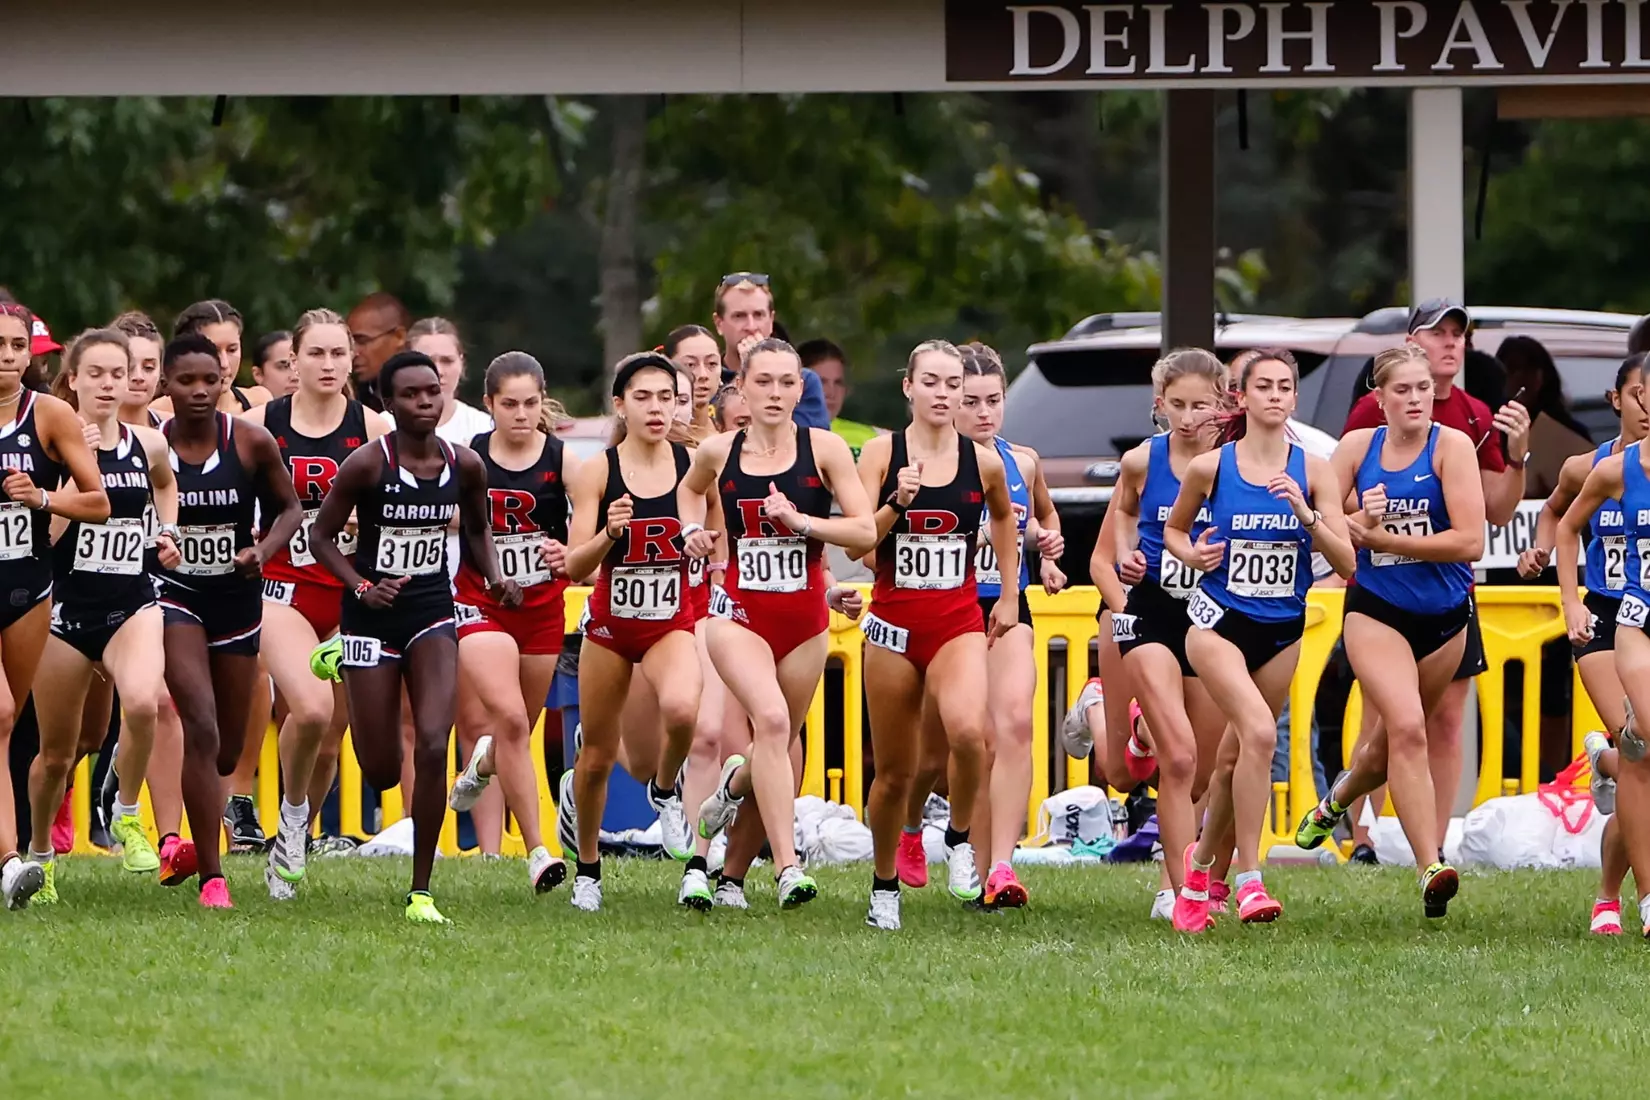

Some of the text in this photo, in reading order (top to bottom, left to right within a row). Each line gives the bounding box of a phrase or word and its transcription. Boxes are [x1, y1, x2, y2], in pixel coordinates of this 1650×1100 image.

[1008, 3, 1334, 76] DELPH
[289, 456, 338, 500] R
[383, 503, 454, 520] CAROLIN
[487, 488, 540, 534] R
[1231, 514, 1299, 530] BUFFALO
[78, 528, 141, 562] 3102
[184, 536, 232, 565] 099
[380, 537, 441, 569] 3105
[623, 517, 682, 564] R
[502, 545, 547, 577] 012
[741, 549, 803, 582] 3010
[898, 546, 960, 578] 3011
[1231, 552, 1294, 585] 2033
[613, 577, 677, 608] 3014
[1190, 594, 1216, 625] 033
[1620, 600, 1644, 622] 32
[864, 618, 898, 647] 3011
